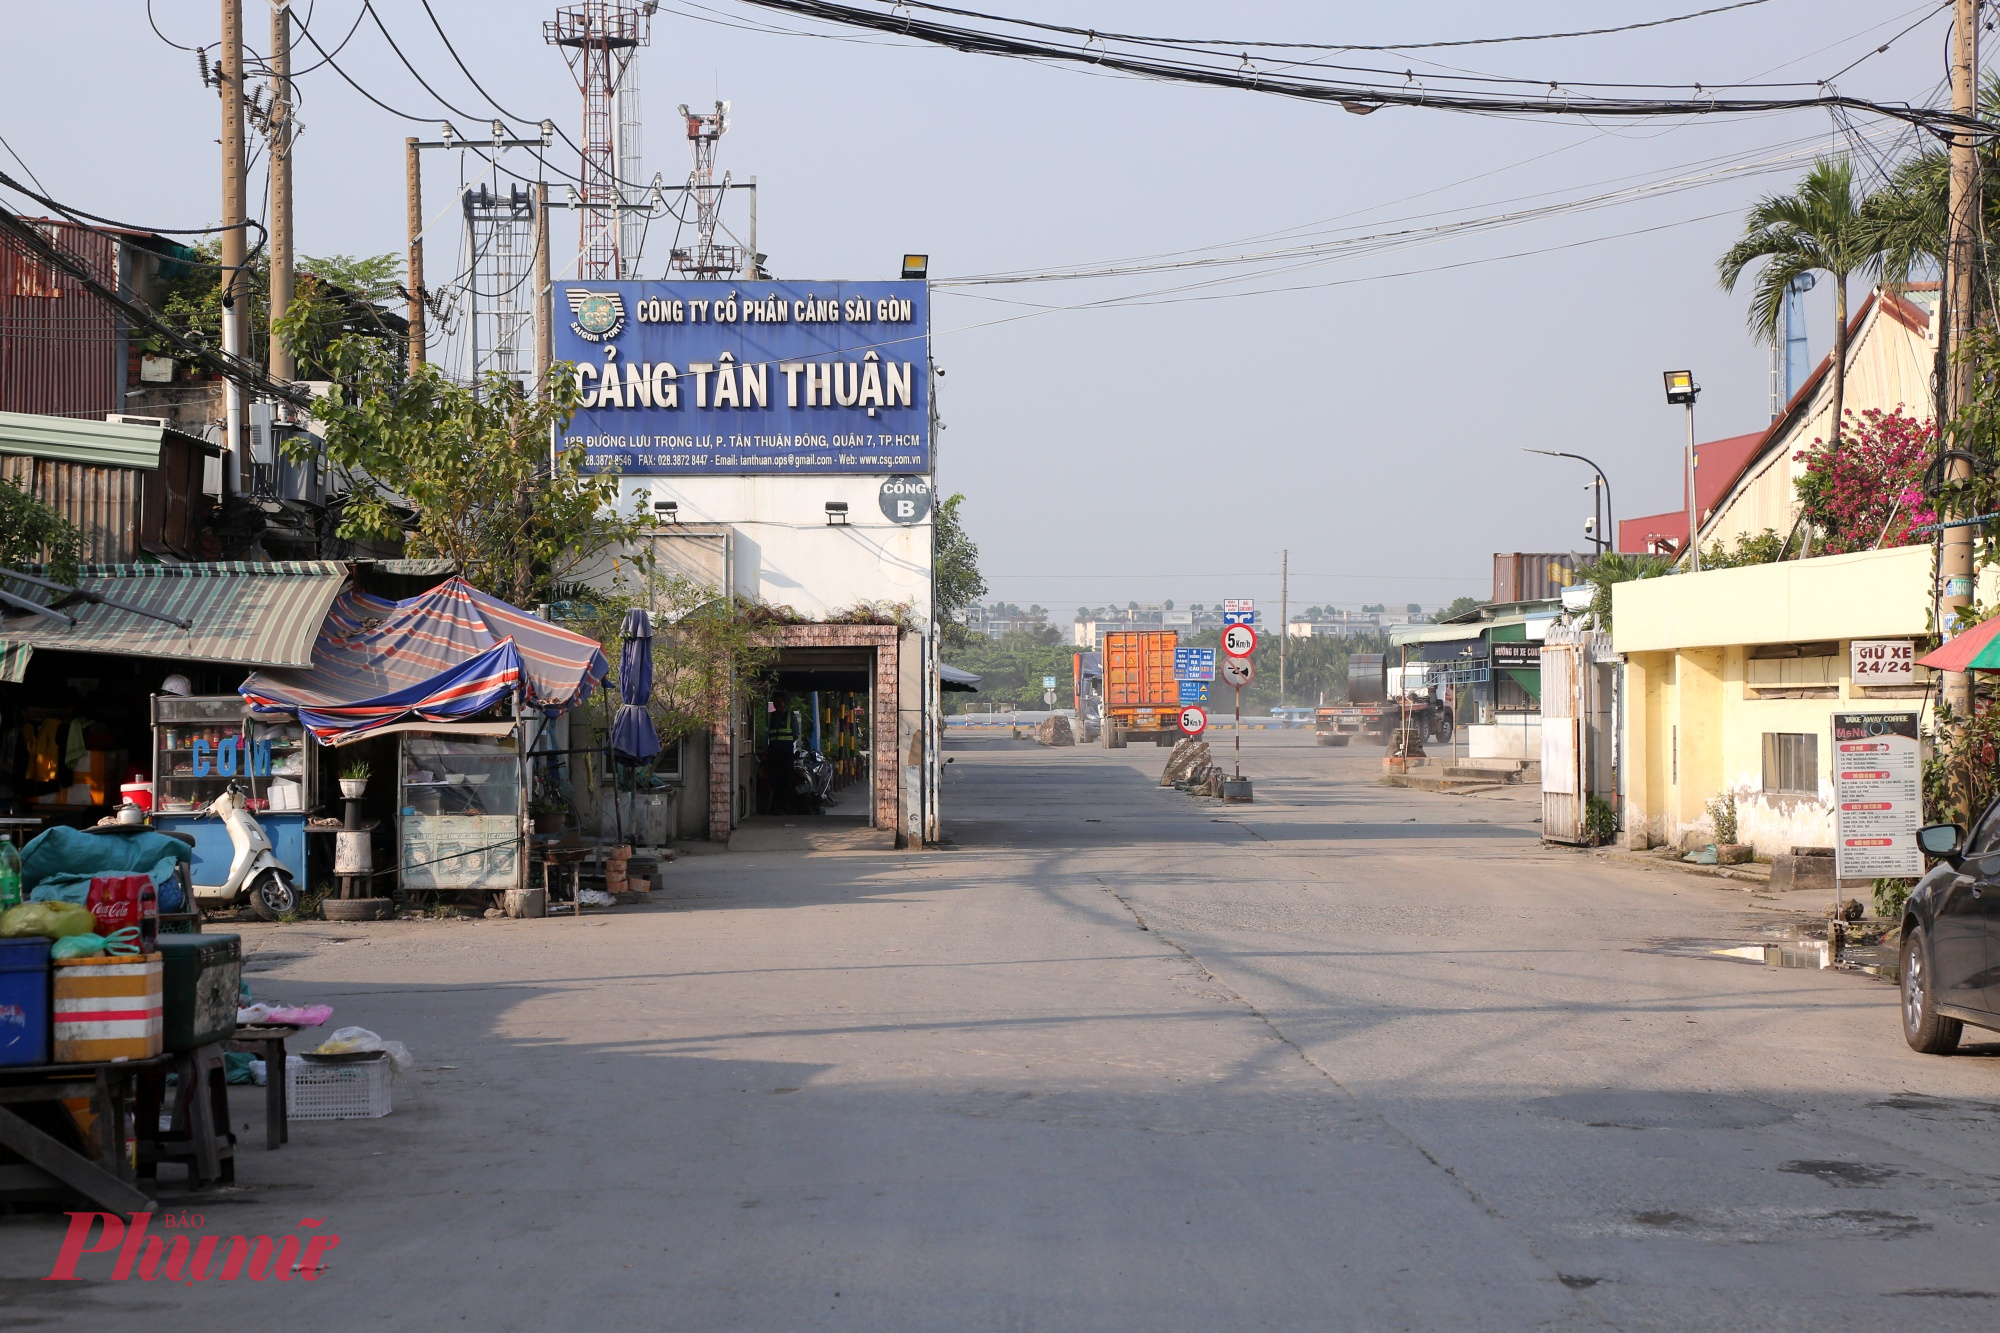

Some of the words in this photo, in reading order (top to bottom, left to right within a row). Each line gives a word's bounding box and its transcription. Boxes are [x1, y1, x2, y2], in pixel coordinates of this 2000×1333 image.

[637, 295, 683, 323] CÔNG
[688, 300, 709, 322] TY
[714, 290, 737, 323] CỔ
[743, 292, 788, 322] PHẦN
[794, 294, 839, 322] CẢNG
[845, 294, 871, 322] SÀI
[877, 294, 911, 322] GÒN
[570, 322, 598, 341] SAIGON
[602, 322, 622, 340] PORT
[574, 344, 678, 408] CẢNG
[689, 352, 767, 408] TÂN
[780, 350, 911, 417] THUẬN
[586, 432, 626, 448] ĐƯỜNG
[630, 435, 651, 448] LƯU
[654, 435, 694, 450] TRỌNG
[696, 434, 713, 450] LƯ,
[716, 436, 726, 448] P.
[730, 434, 751, 447] TÂN
[754, 434, 792, 449] THUẬN
[794, 432, 829, 449] ĐÔNG,
[832, 432, 864, 449] QUẬN
[866, 435, 876, 448] 7,
[638, 455, 656, 466] FAX:
[658, 454, 690, 466] 028.3872
[692, 454, 708, 466] 8447
[715, 454, 738, 466] Email:
[740, 454, 832, 468] tanthuan.ops@gmail.com
[839, 454, 858, 465] Web:
[859, 455, 921, 468] www.csg.com.vn
[883, 478, 927, 494] CỔNG
[897, 500, 915, 517] B
[1228, 633, 1235, 648] 5
[1520, 648, 1526, 656] XE
[1860, 644, 1887, 659] GIỮ
[1891, 647, 1912, 659] XE
[1857, 661, 1912, 673] 24/24
[1184, 714, 1189, 726] 5
[193, 735, 271, 777] CƠM
[91, 901, 130, 917] Coca-Cola
